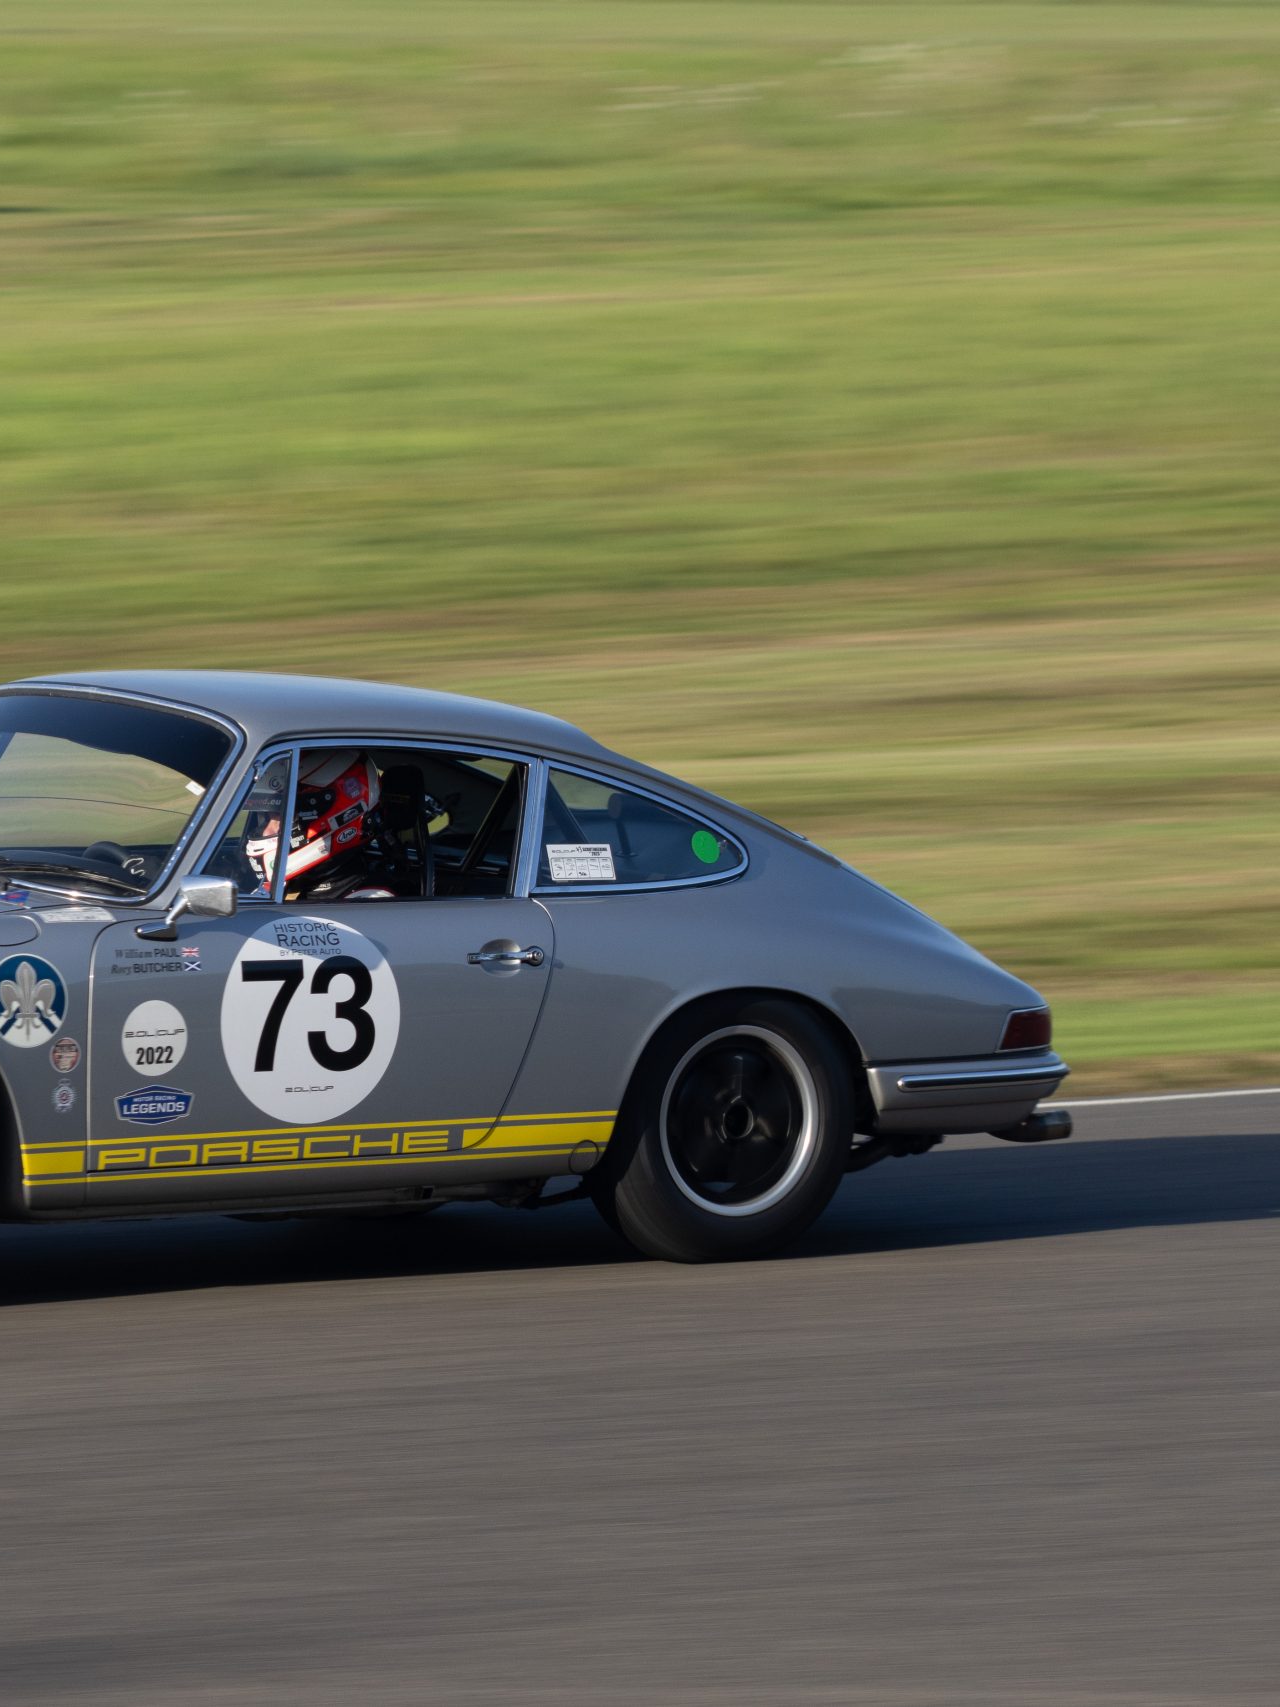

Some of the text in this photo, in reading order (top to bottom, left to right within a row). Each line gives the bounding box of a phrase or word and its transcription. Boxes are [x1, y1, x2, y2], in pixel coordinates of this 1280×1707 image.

[273, 922, 337, 933] HISTORIC
[276, 932, 340, 947] RACING
[153, 948, 180, 958] PAUL
[292, 948, 318, 956] PETER
[133, 962, 183, 973] BUTCHER
[241, 955, 376, 1073] 73
[136, 1045, 173, 1065] 2022
[122, 1101, 186, 1115] LEGENDS
[97, 1130, 449, 1171] PORSCHE
